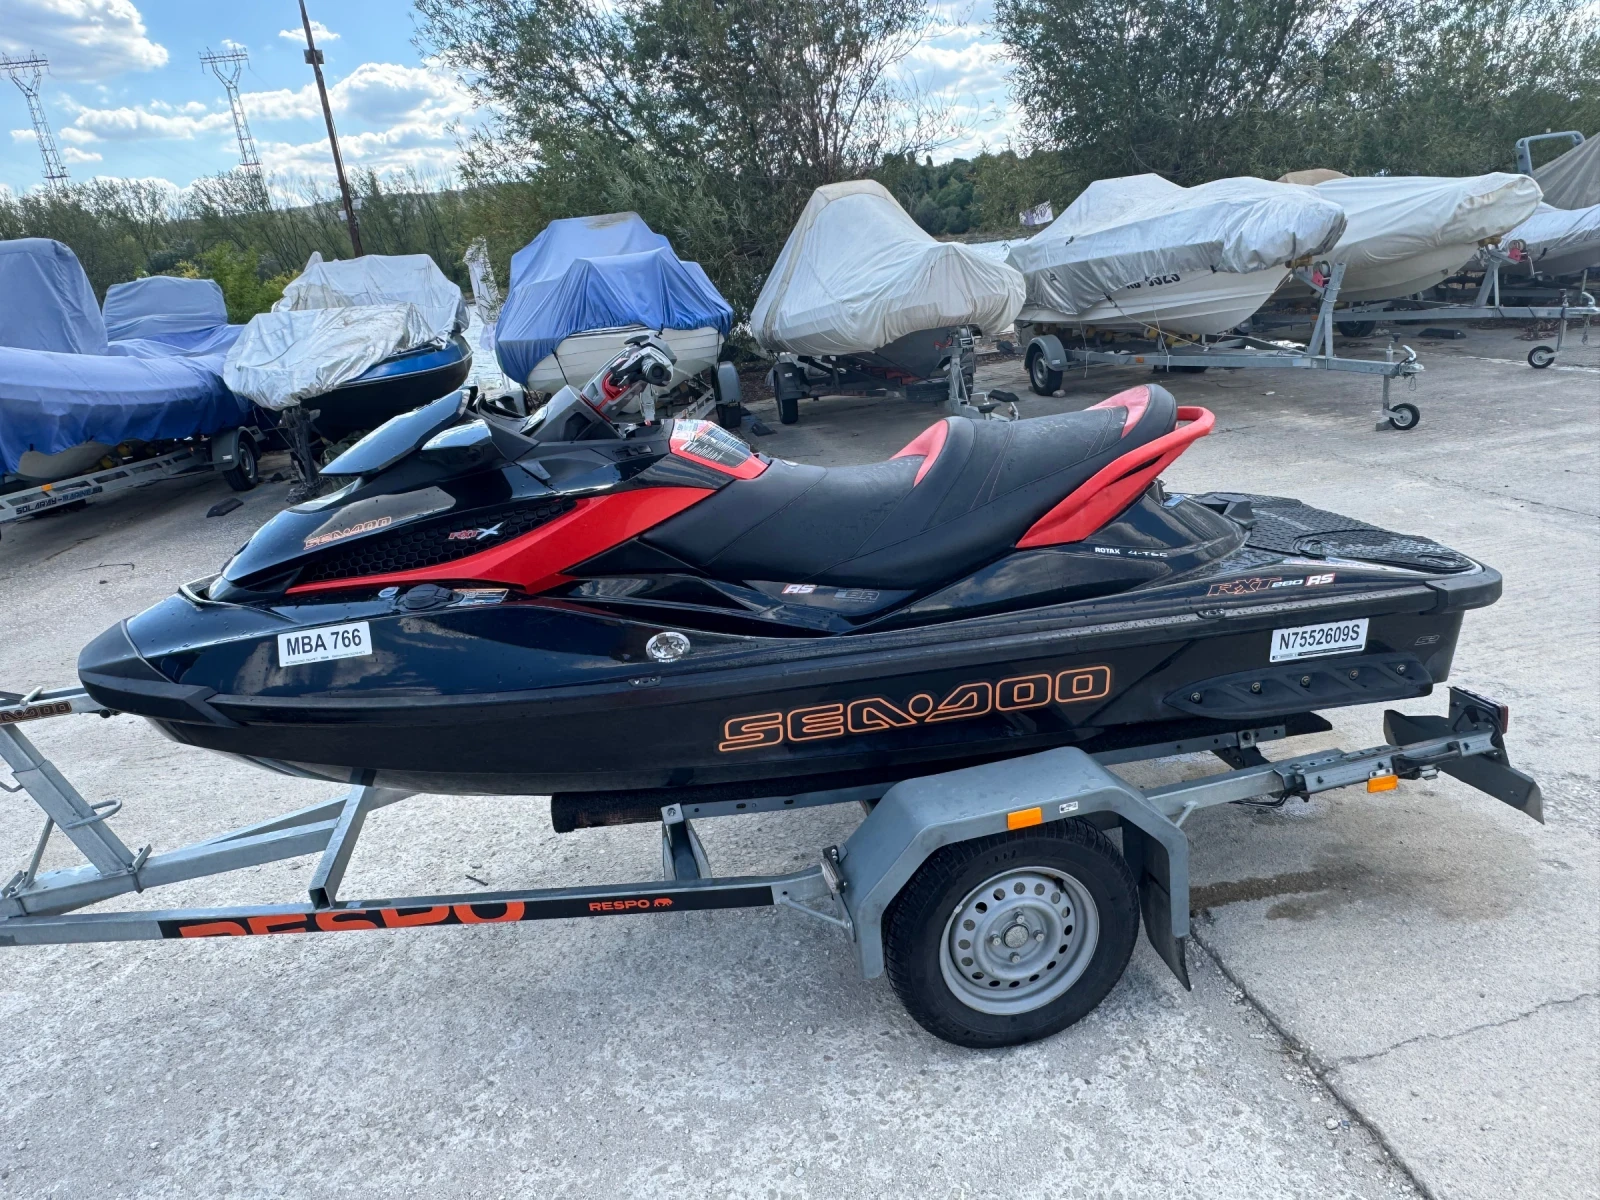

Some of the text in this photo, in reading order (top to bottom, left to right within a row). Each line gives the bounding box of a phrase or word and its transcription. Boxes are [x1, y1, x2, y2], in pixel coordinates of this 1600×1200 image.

[1094, 547, 1121, 555] ROTAX
[286, 628, 362, 656] MBA 766
[1279, 624, 1361, 651] N7552609S
[588, 899, 651, 911] RESPO
